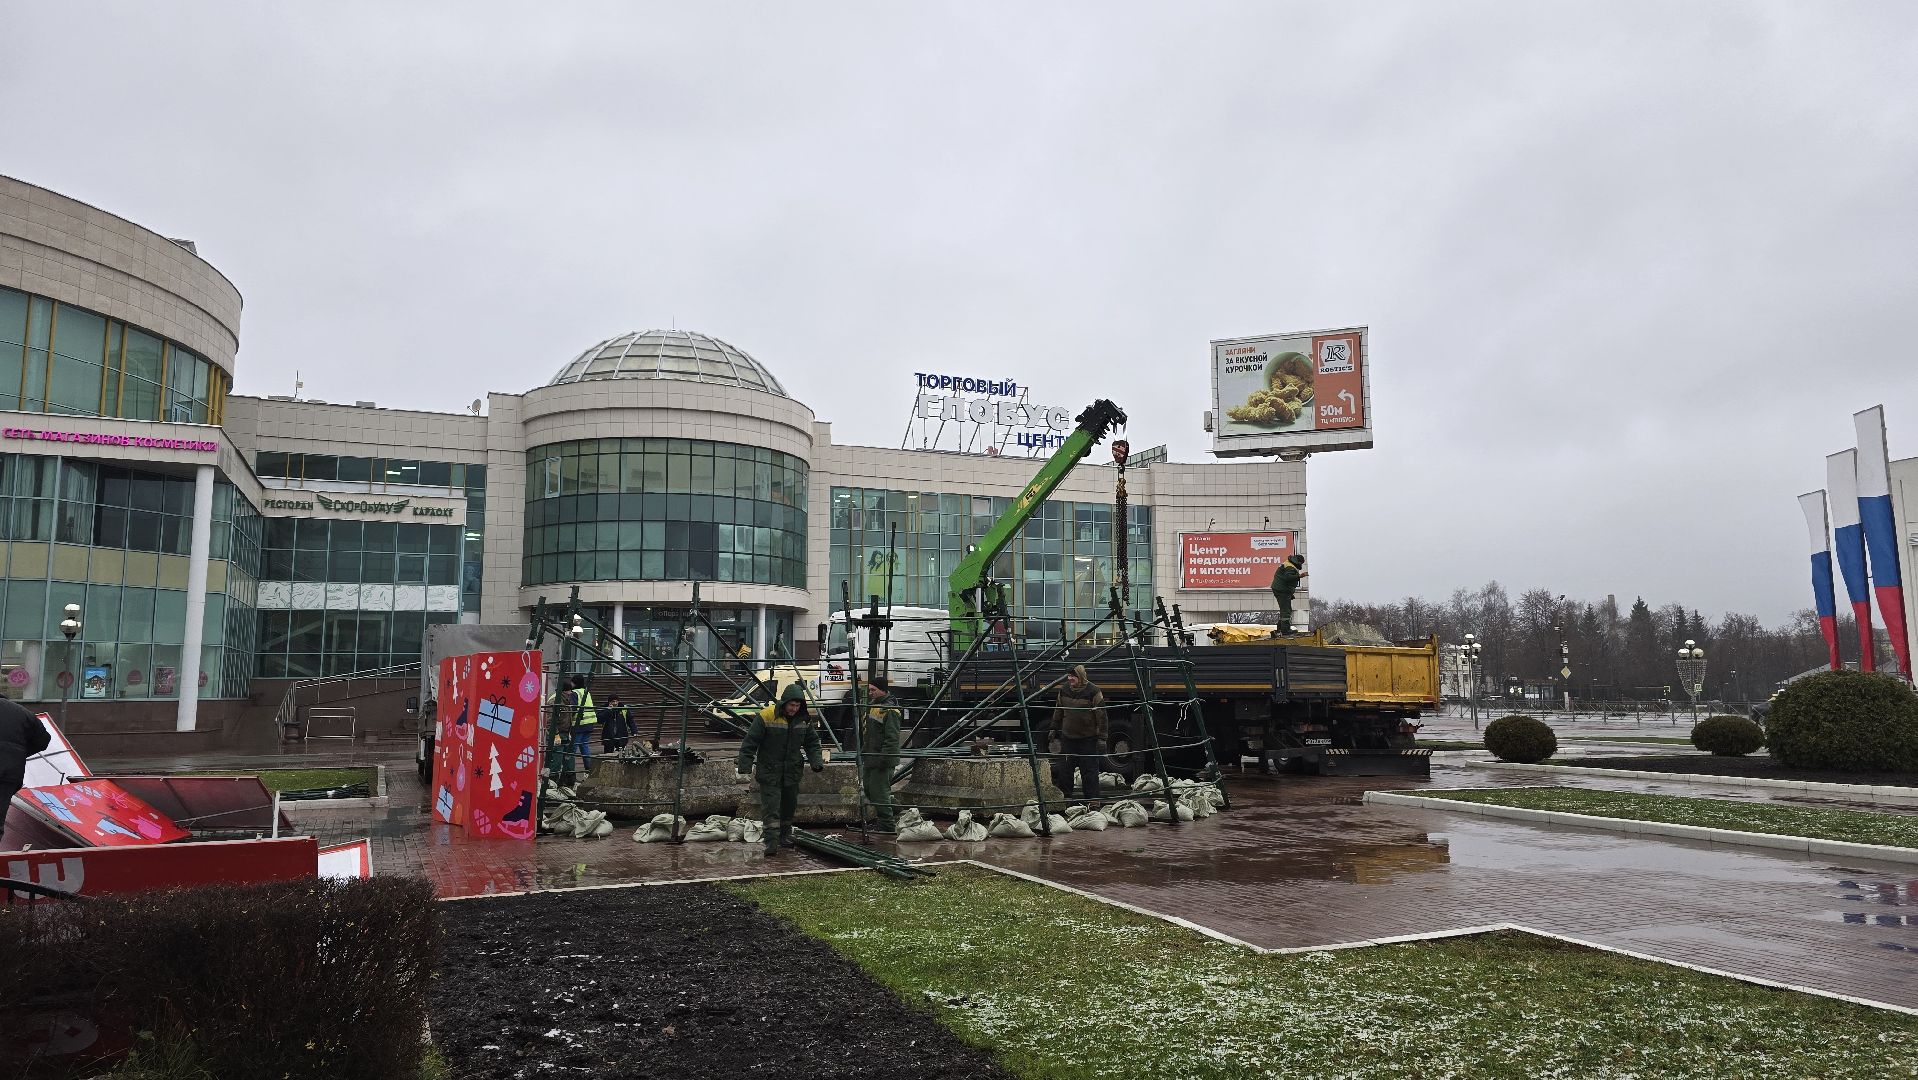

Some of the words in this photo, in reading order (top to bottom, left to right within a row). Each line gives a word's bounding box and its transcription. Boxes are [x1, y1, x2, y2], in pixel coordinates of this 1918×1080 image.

[1226, 347, 1256, 355] ЗАГЛЯНИ
[1235, 352, 1268, 364] ВКУСНОЙ
[1226, 362, 1263, 374] КУРОЧКОЙ
[915, 372, 1017, 397] ТОРГОВЫЙ
[917, 394, 1070, 431] ГЛОБУС
[2, 427, 36, 440] СЕТЬ
[41, 430, 130, 446] МАГАЗИНОВ
[134, 436, 218, 452] КОСМЕТИКИ
[1017, 432, 1069, 449] ЦЕНТ
[264, 499, 314, 511] РЕСТОРАН
[412, 506, 454, 517] КАРАОКЕ
[1189, 543, 1227, 556] Центр
[1189, 556, 1281, 565] недвижимости
[1189, 567, 1196, 575] и
[1199, 567, 1251, 575] ипотеки
